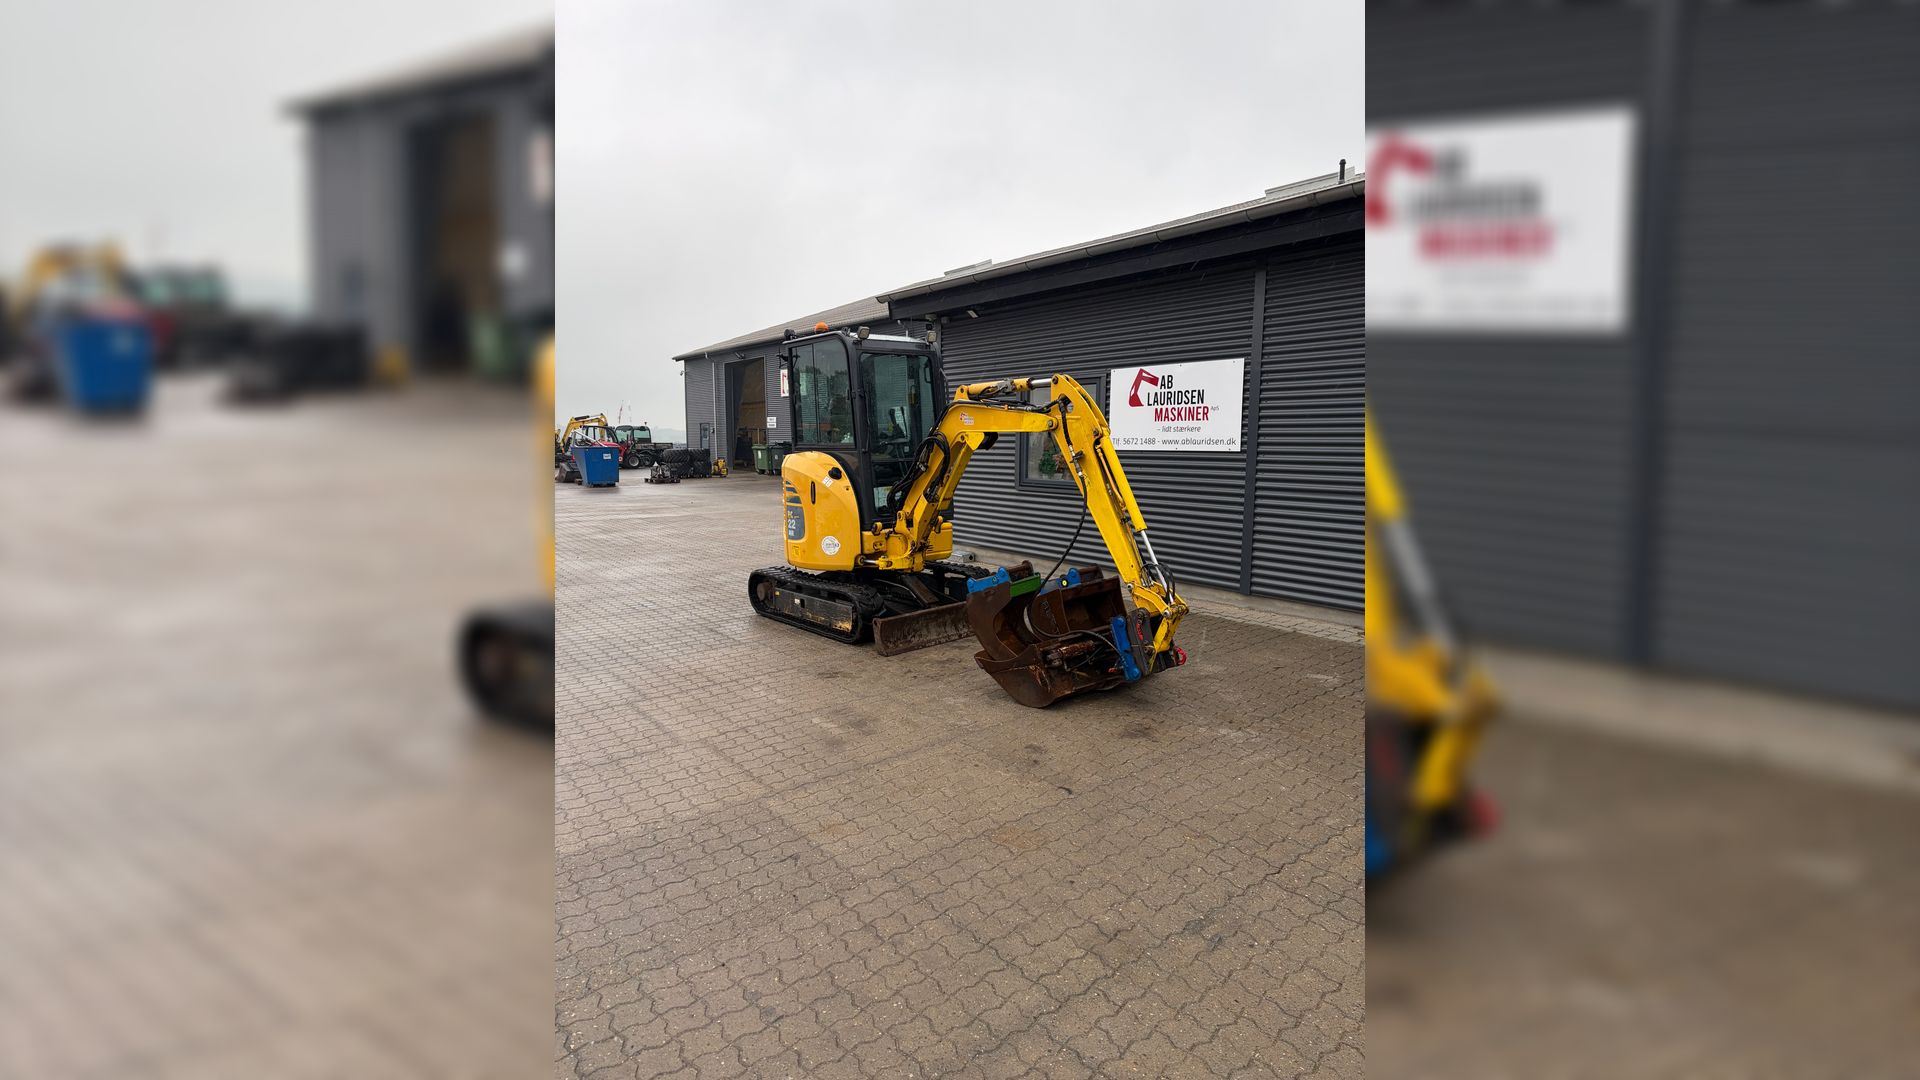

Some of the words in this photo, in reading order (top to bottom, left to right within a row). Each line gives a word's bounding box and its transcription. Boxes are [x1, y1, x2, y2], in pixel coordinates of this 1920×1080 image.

[1160, 374, 1174, 390] AB
[1147, 389, 1205, 406] LAURIDSEN
[1154, 406, 1209, 422] MASKINER
[1123, 437, 1139, 445] 5672
[1139, 437, 1156, 445] 1488
[1161, 437, 1237, 446] www.ablauridsen.dk
